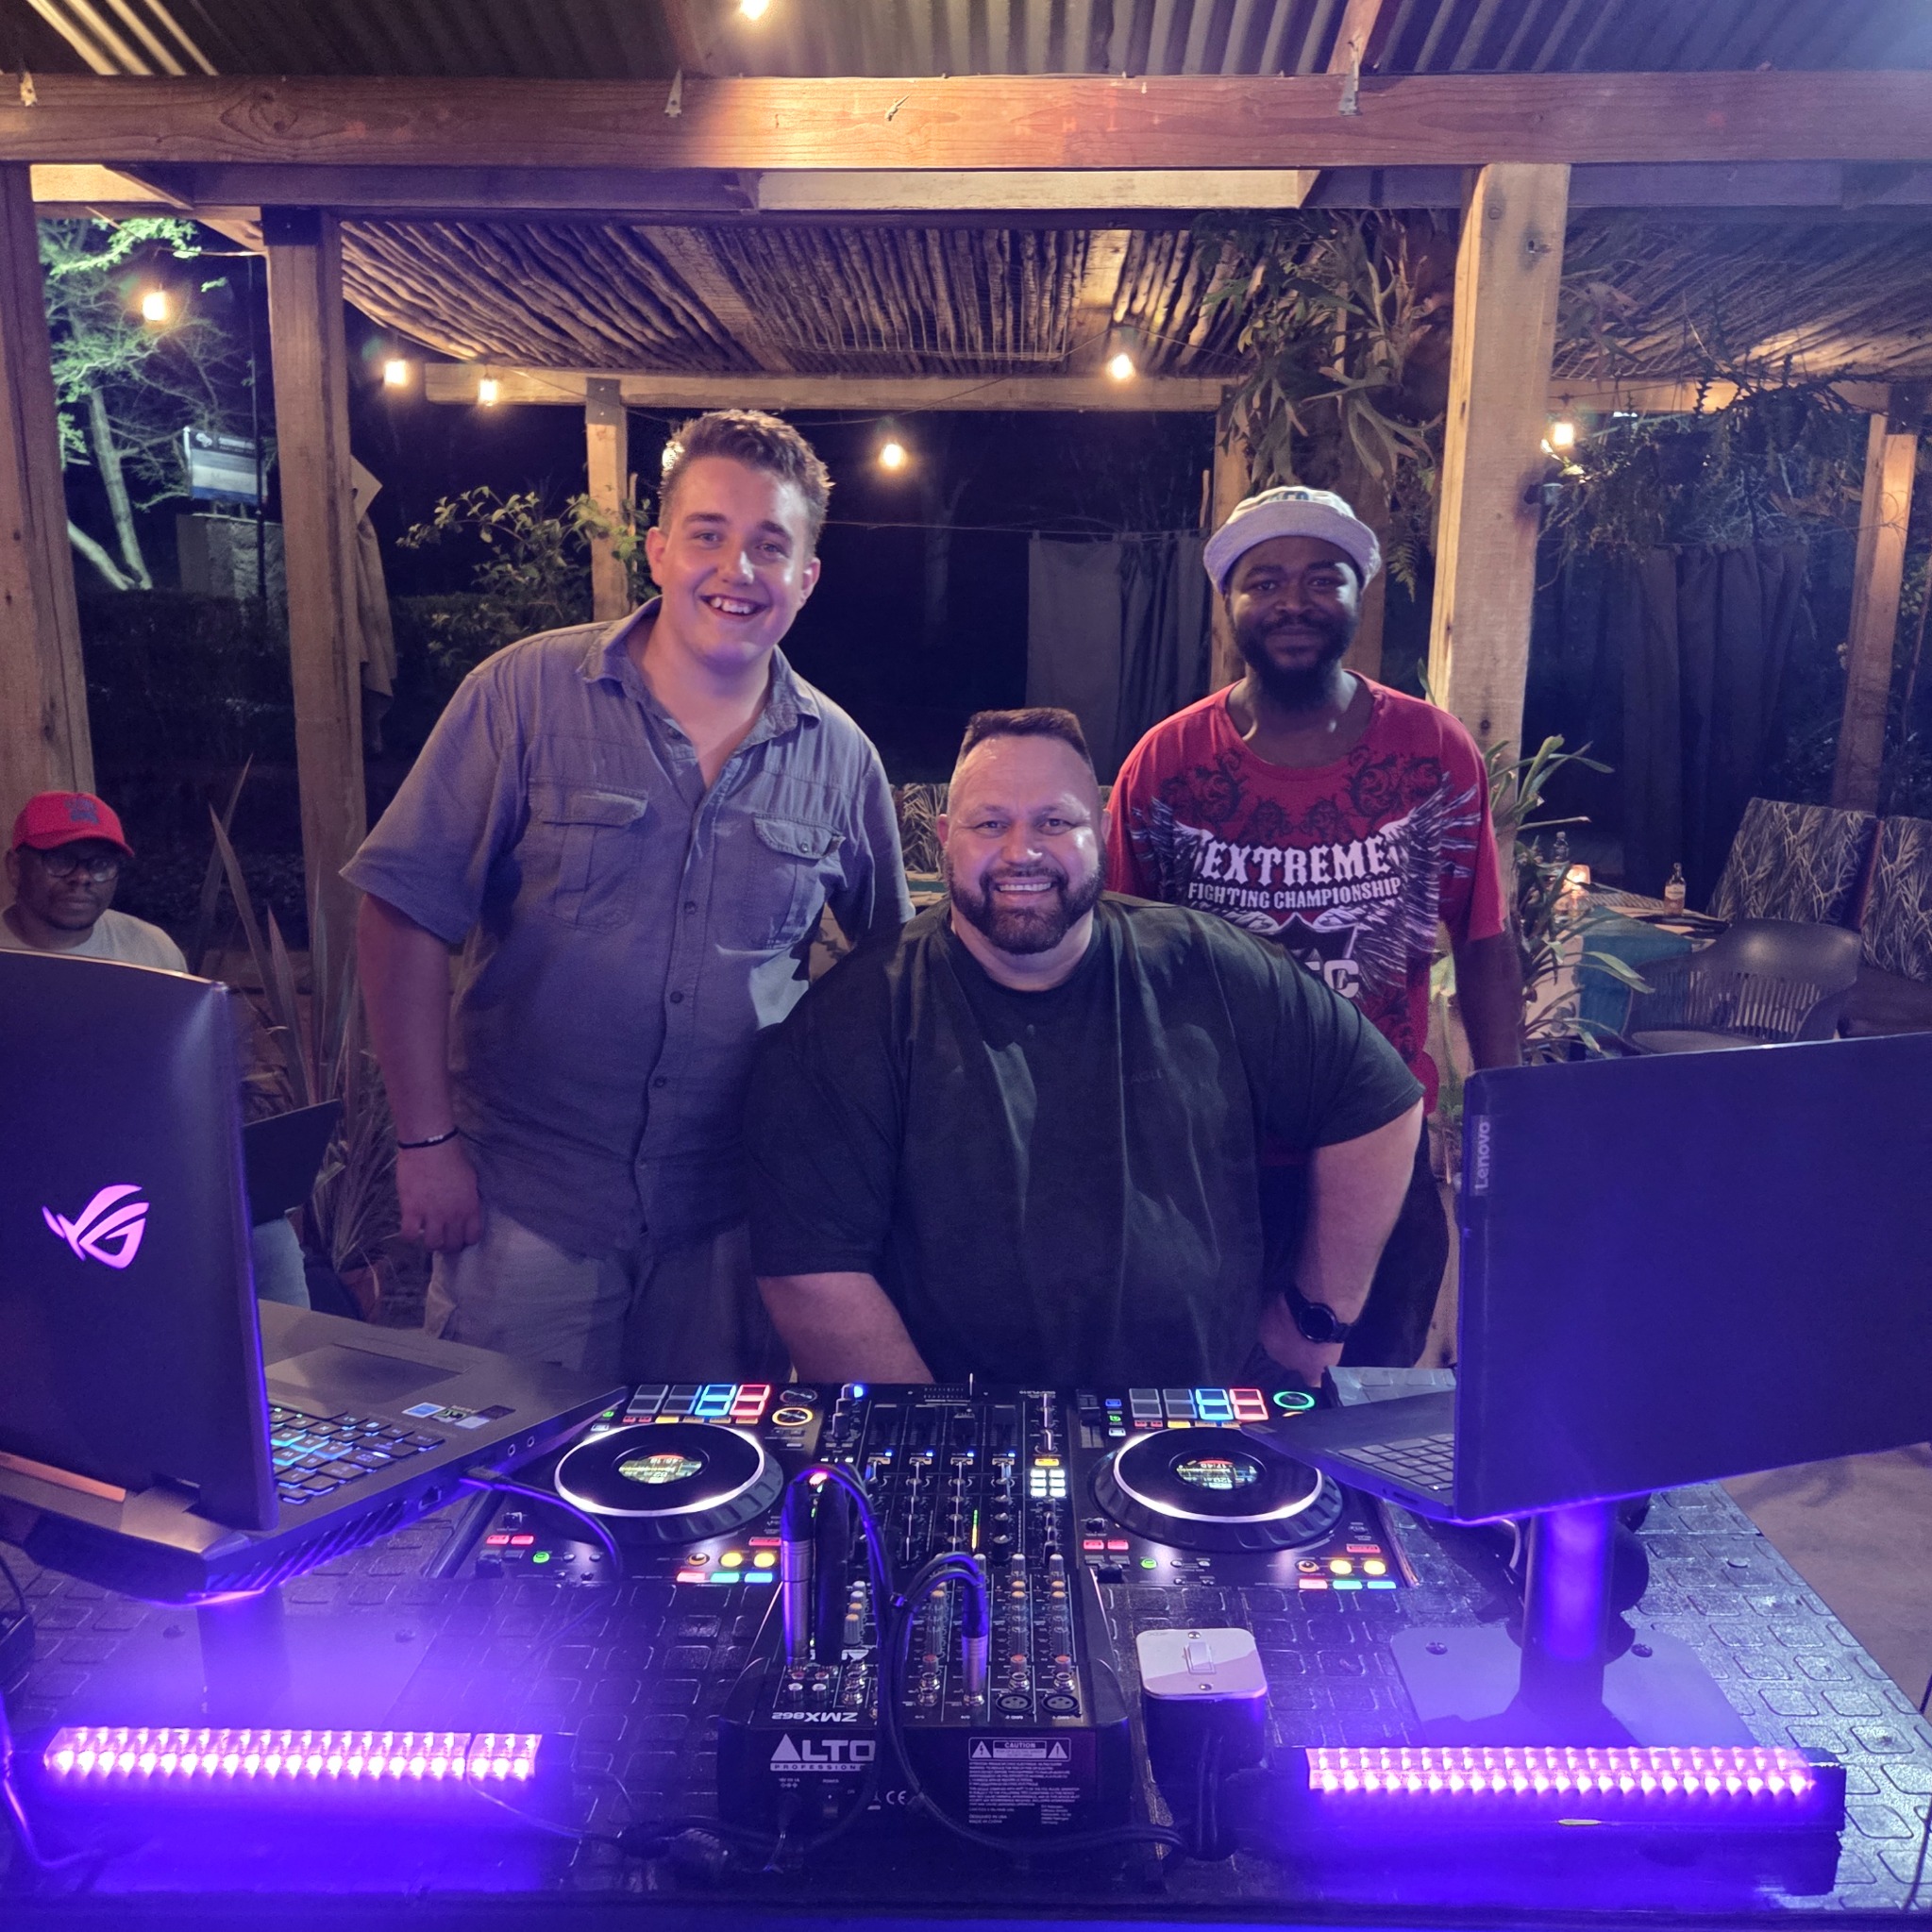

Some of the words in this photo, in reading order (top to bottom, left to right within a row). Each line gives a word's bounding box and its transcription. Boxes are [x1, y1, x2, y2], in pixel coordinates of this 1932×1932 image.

[1201, 836, 1393, 885] EXTREME
[1187, 882, 1270, 909] FIGHTING
[1273, 877, 1403, 909] CHAMPIONSHIP
[1474, 1121, 1491, 1189] Lenovo
[771, 1711, 859, 1722] ZMX862
[770, 1733, 876, 1762] ALTO
